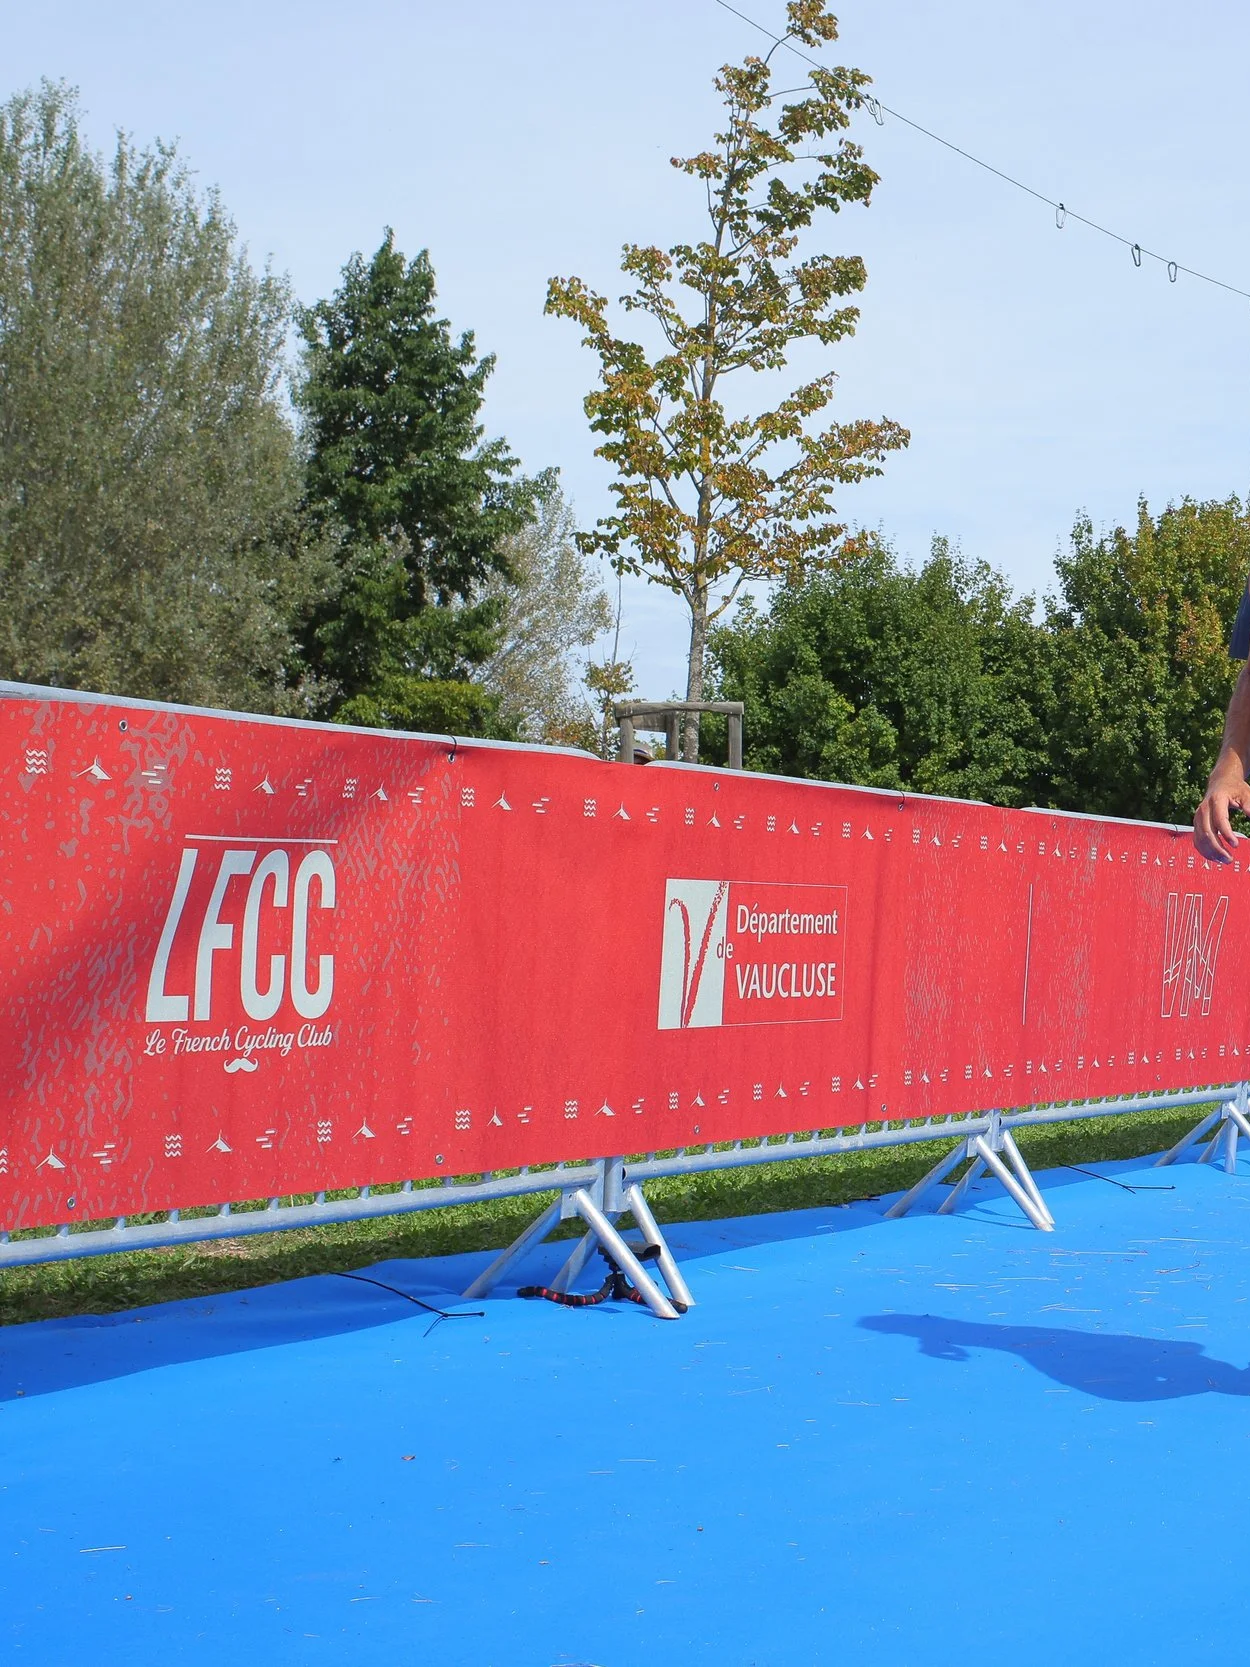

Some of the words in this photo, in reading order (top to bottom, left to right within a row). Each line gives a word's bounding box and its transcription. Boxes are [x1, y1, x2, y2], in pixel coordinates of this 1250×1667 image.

[145, 848, 336, 1024] LFCC
[736, 902, 838, 943] Département
[716, 936, 734, 959] de
[735, 962, 836, 999] VAUCLUSE
[143, 1028, 166, 1056] Le
[171, 1028, 231, 1055] French
[234, 1025, 294, 1058] Cycling
[297, 1023, 333, 1048] Club
